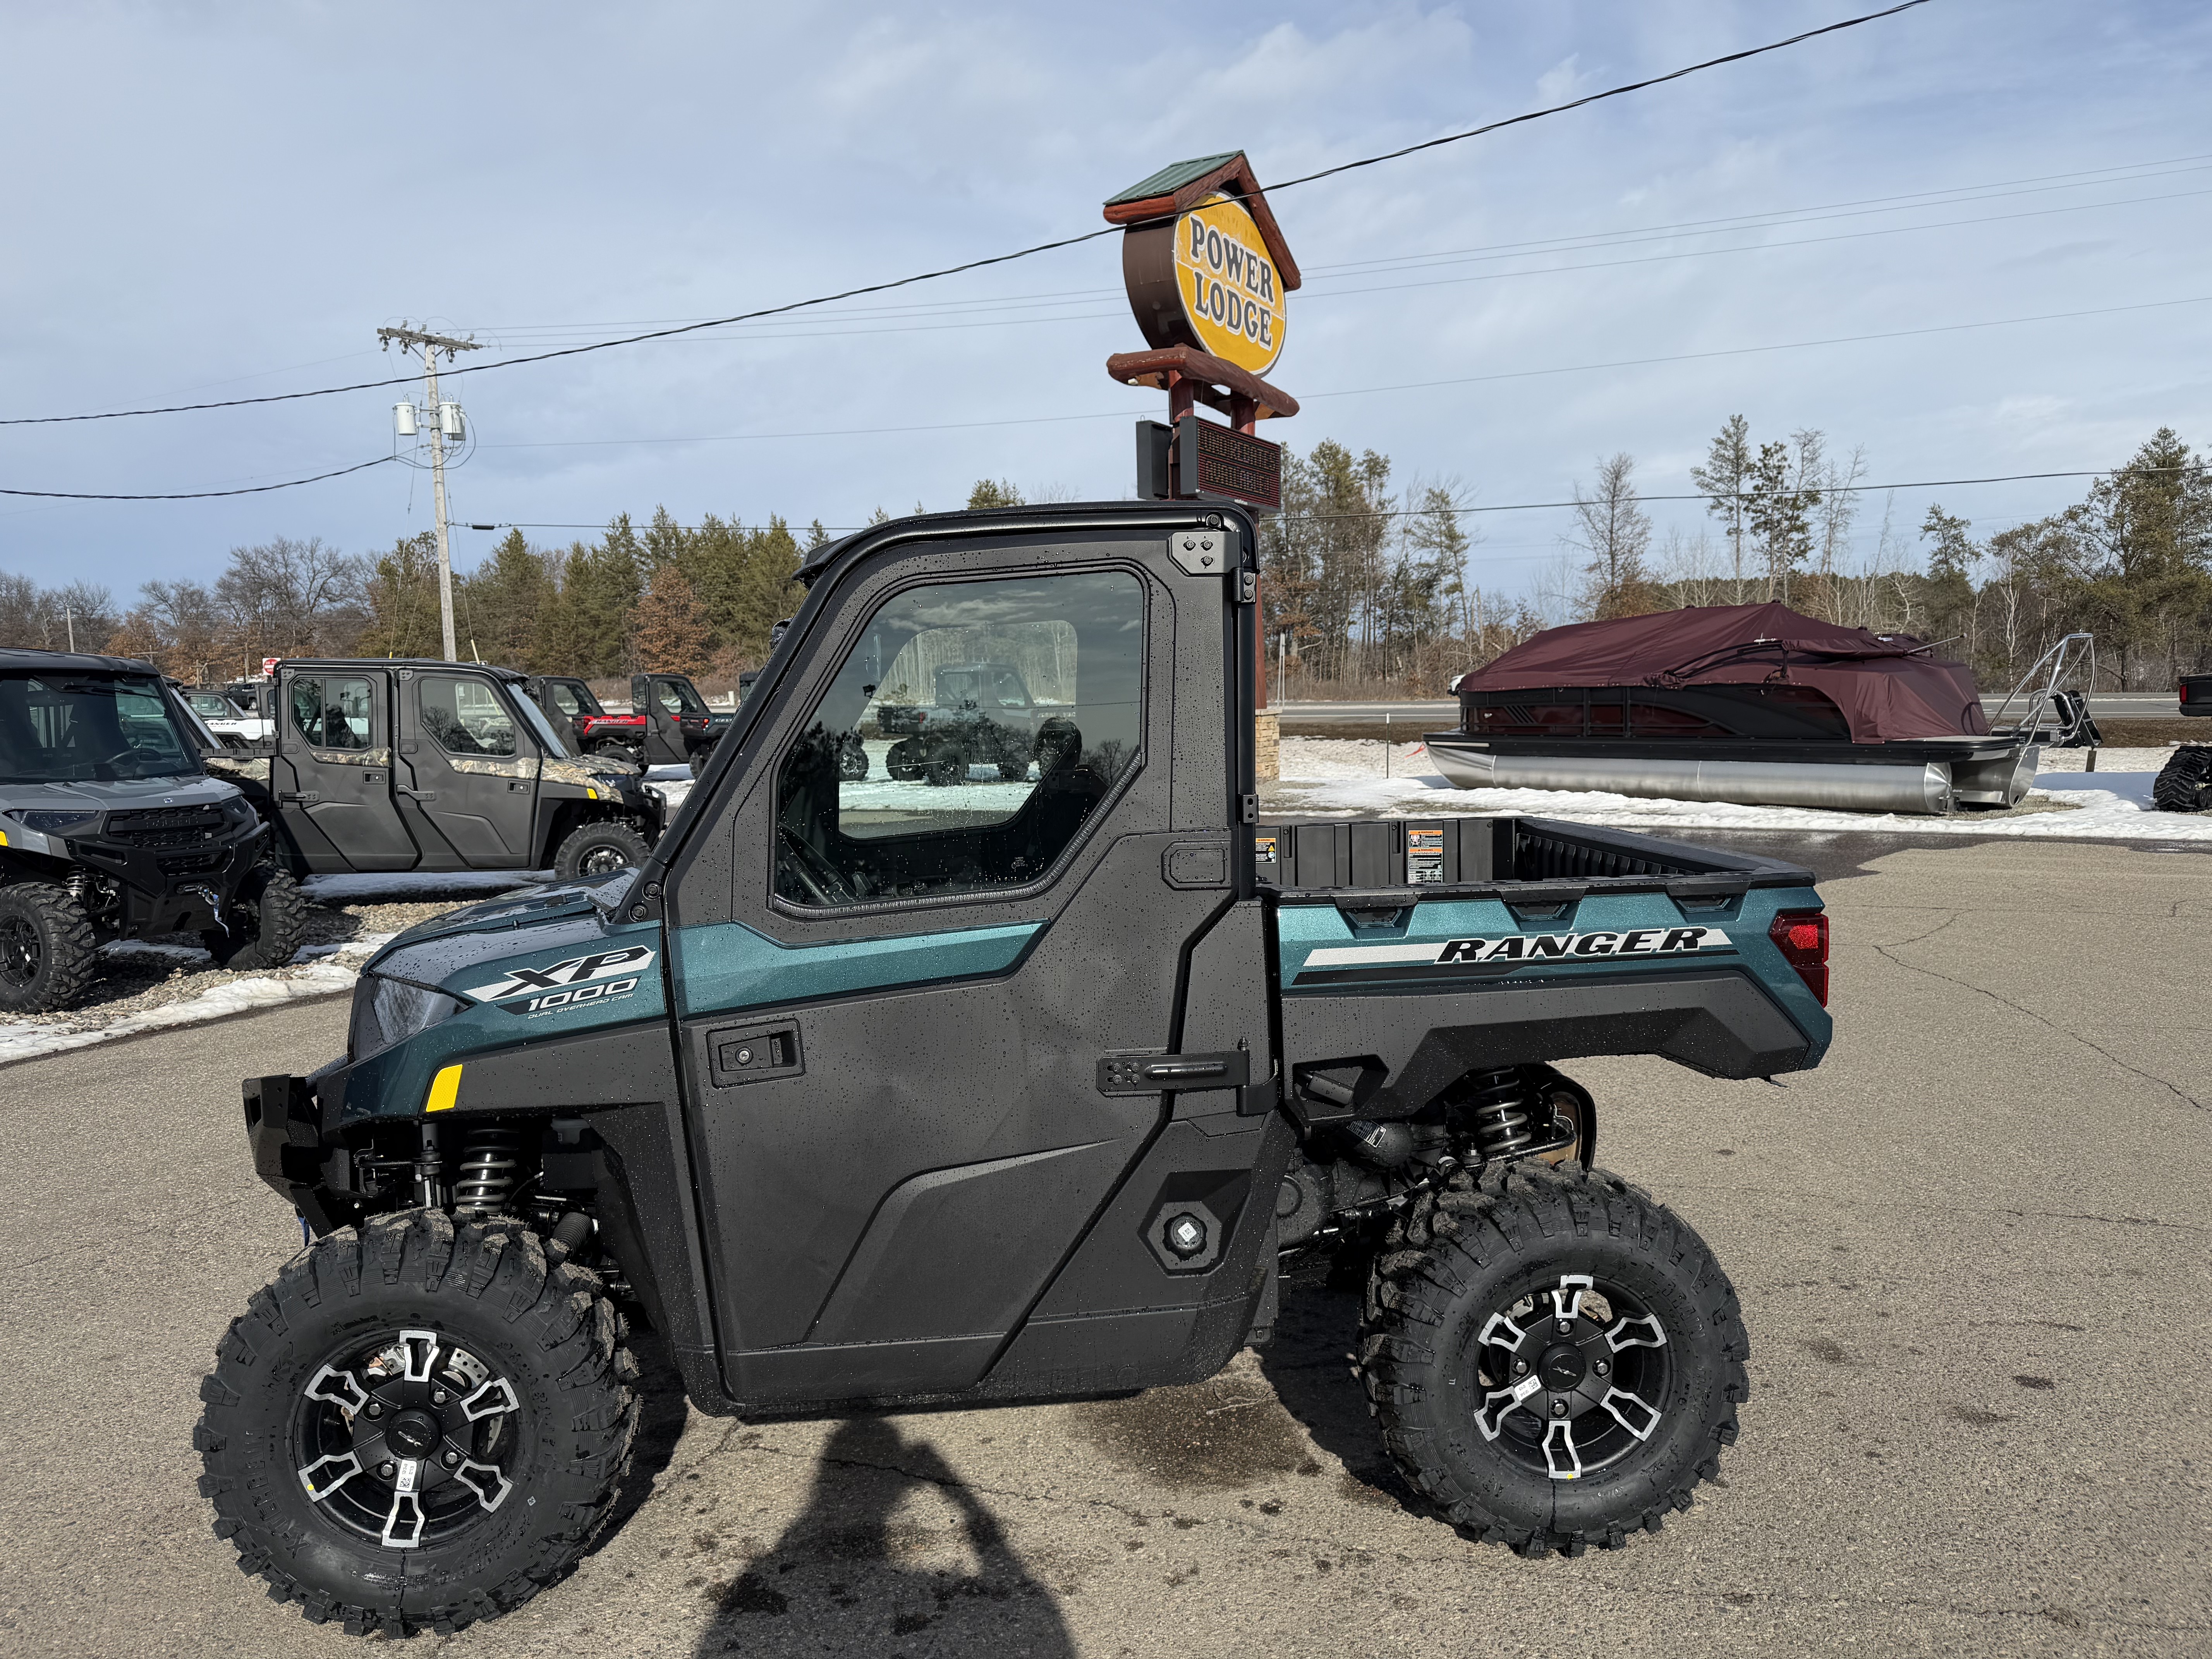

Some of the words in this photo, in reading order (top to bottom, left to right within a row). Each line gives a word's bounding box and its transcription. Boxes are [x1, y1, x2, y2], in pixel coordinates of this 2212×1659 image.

[1190, 216, 1274, 303] POWER
[1195, 271, 1272, 347] LODGE
[1230, 439, 1276, 472] REBATES
[1435, 928, 1707, 963] RANGER
[489, 946, 651, 1000] XP
[528, 977, 637, 1012] 1000
[527, 1011, 554, 1019] DUAL
[556, 999, 610, 1013] OVERHEAD
[611, 993, 634, 1001] CAM
[245, 1428, 311, 1559] X-TERRAIN
